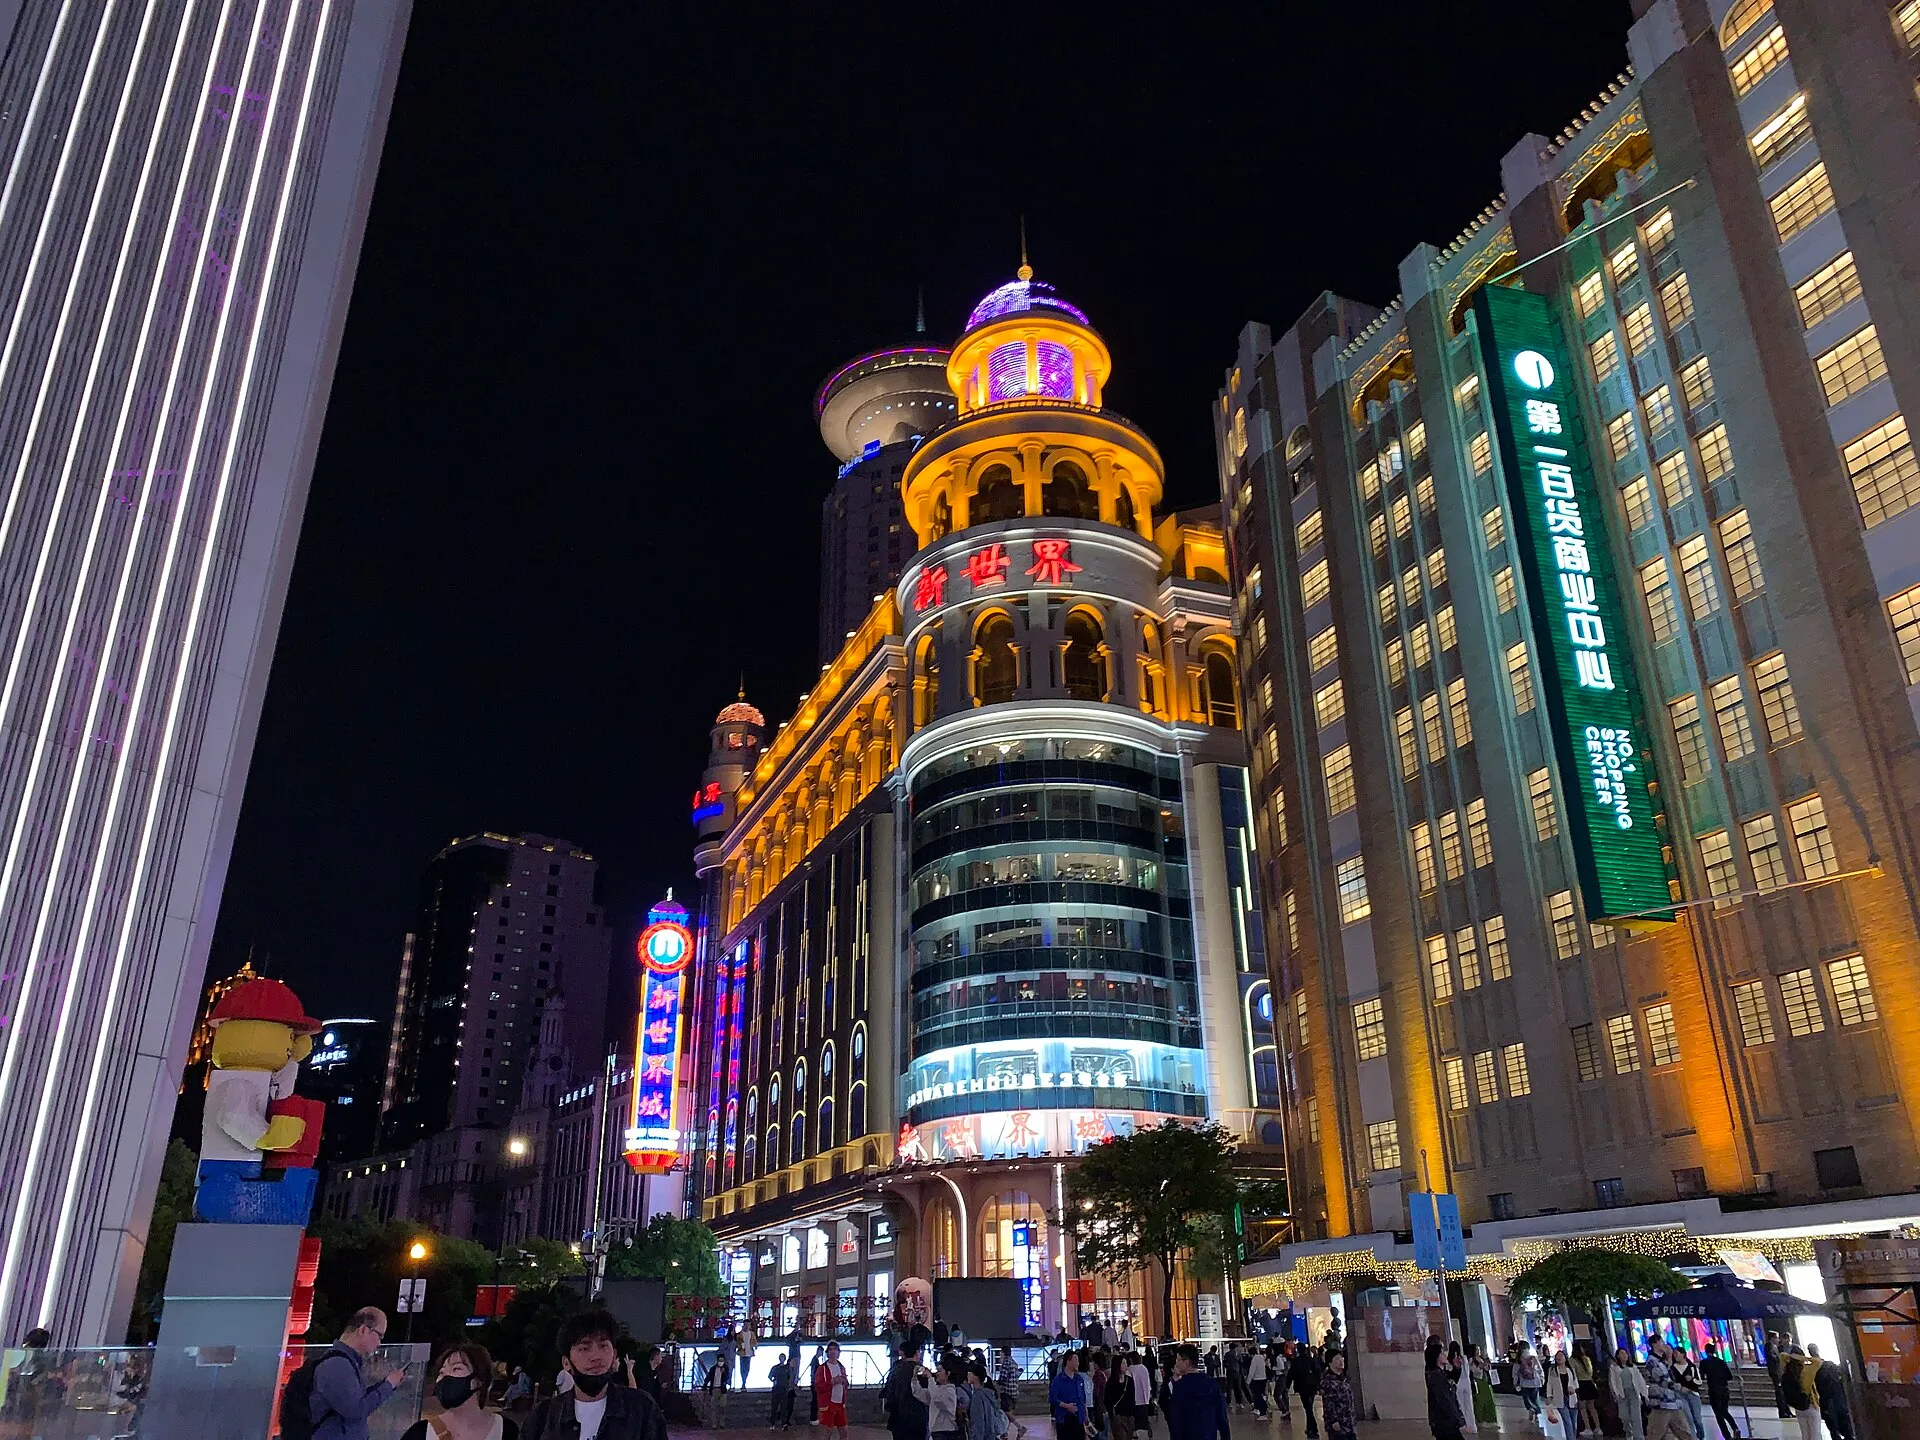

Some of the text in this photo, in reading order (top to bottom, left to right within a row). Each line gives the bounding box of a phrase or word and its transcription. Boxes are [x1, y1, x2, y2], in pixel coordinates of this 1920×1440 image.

[912, 539, 1084, 612] 新世界
[1526, 400, 1616, 690] 第一百货商业中心
[1585, 725, 1613, 805] CENTER
[1600, 727, 1633, 830] SHOPPING
[638, 984, 677, 1119] 新世界城
[1663, 1305, 1694, 1315] POLICE
